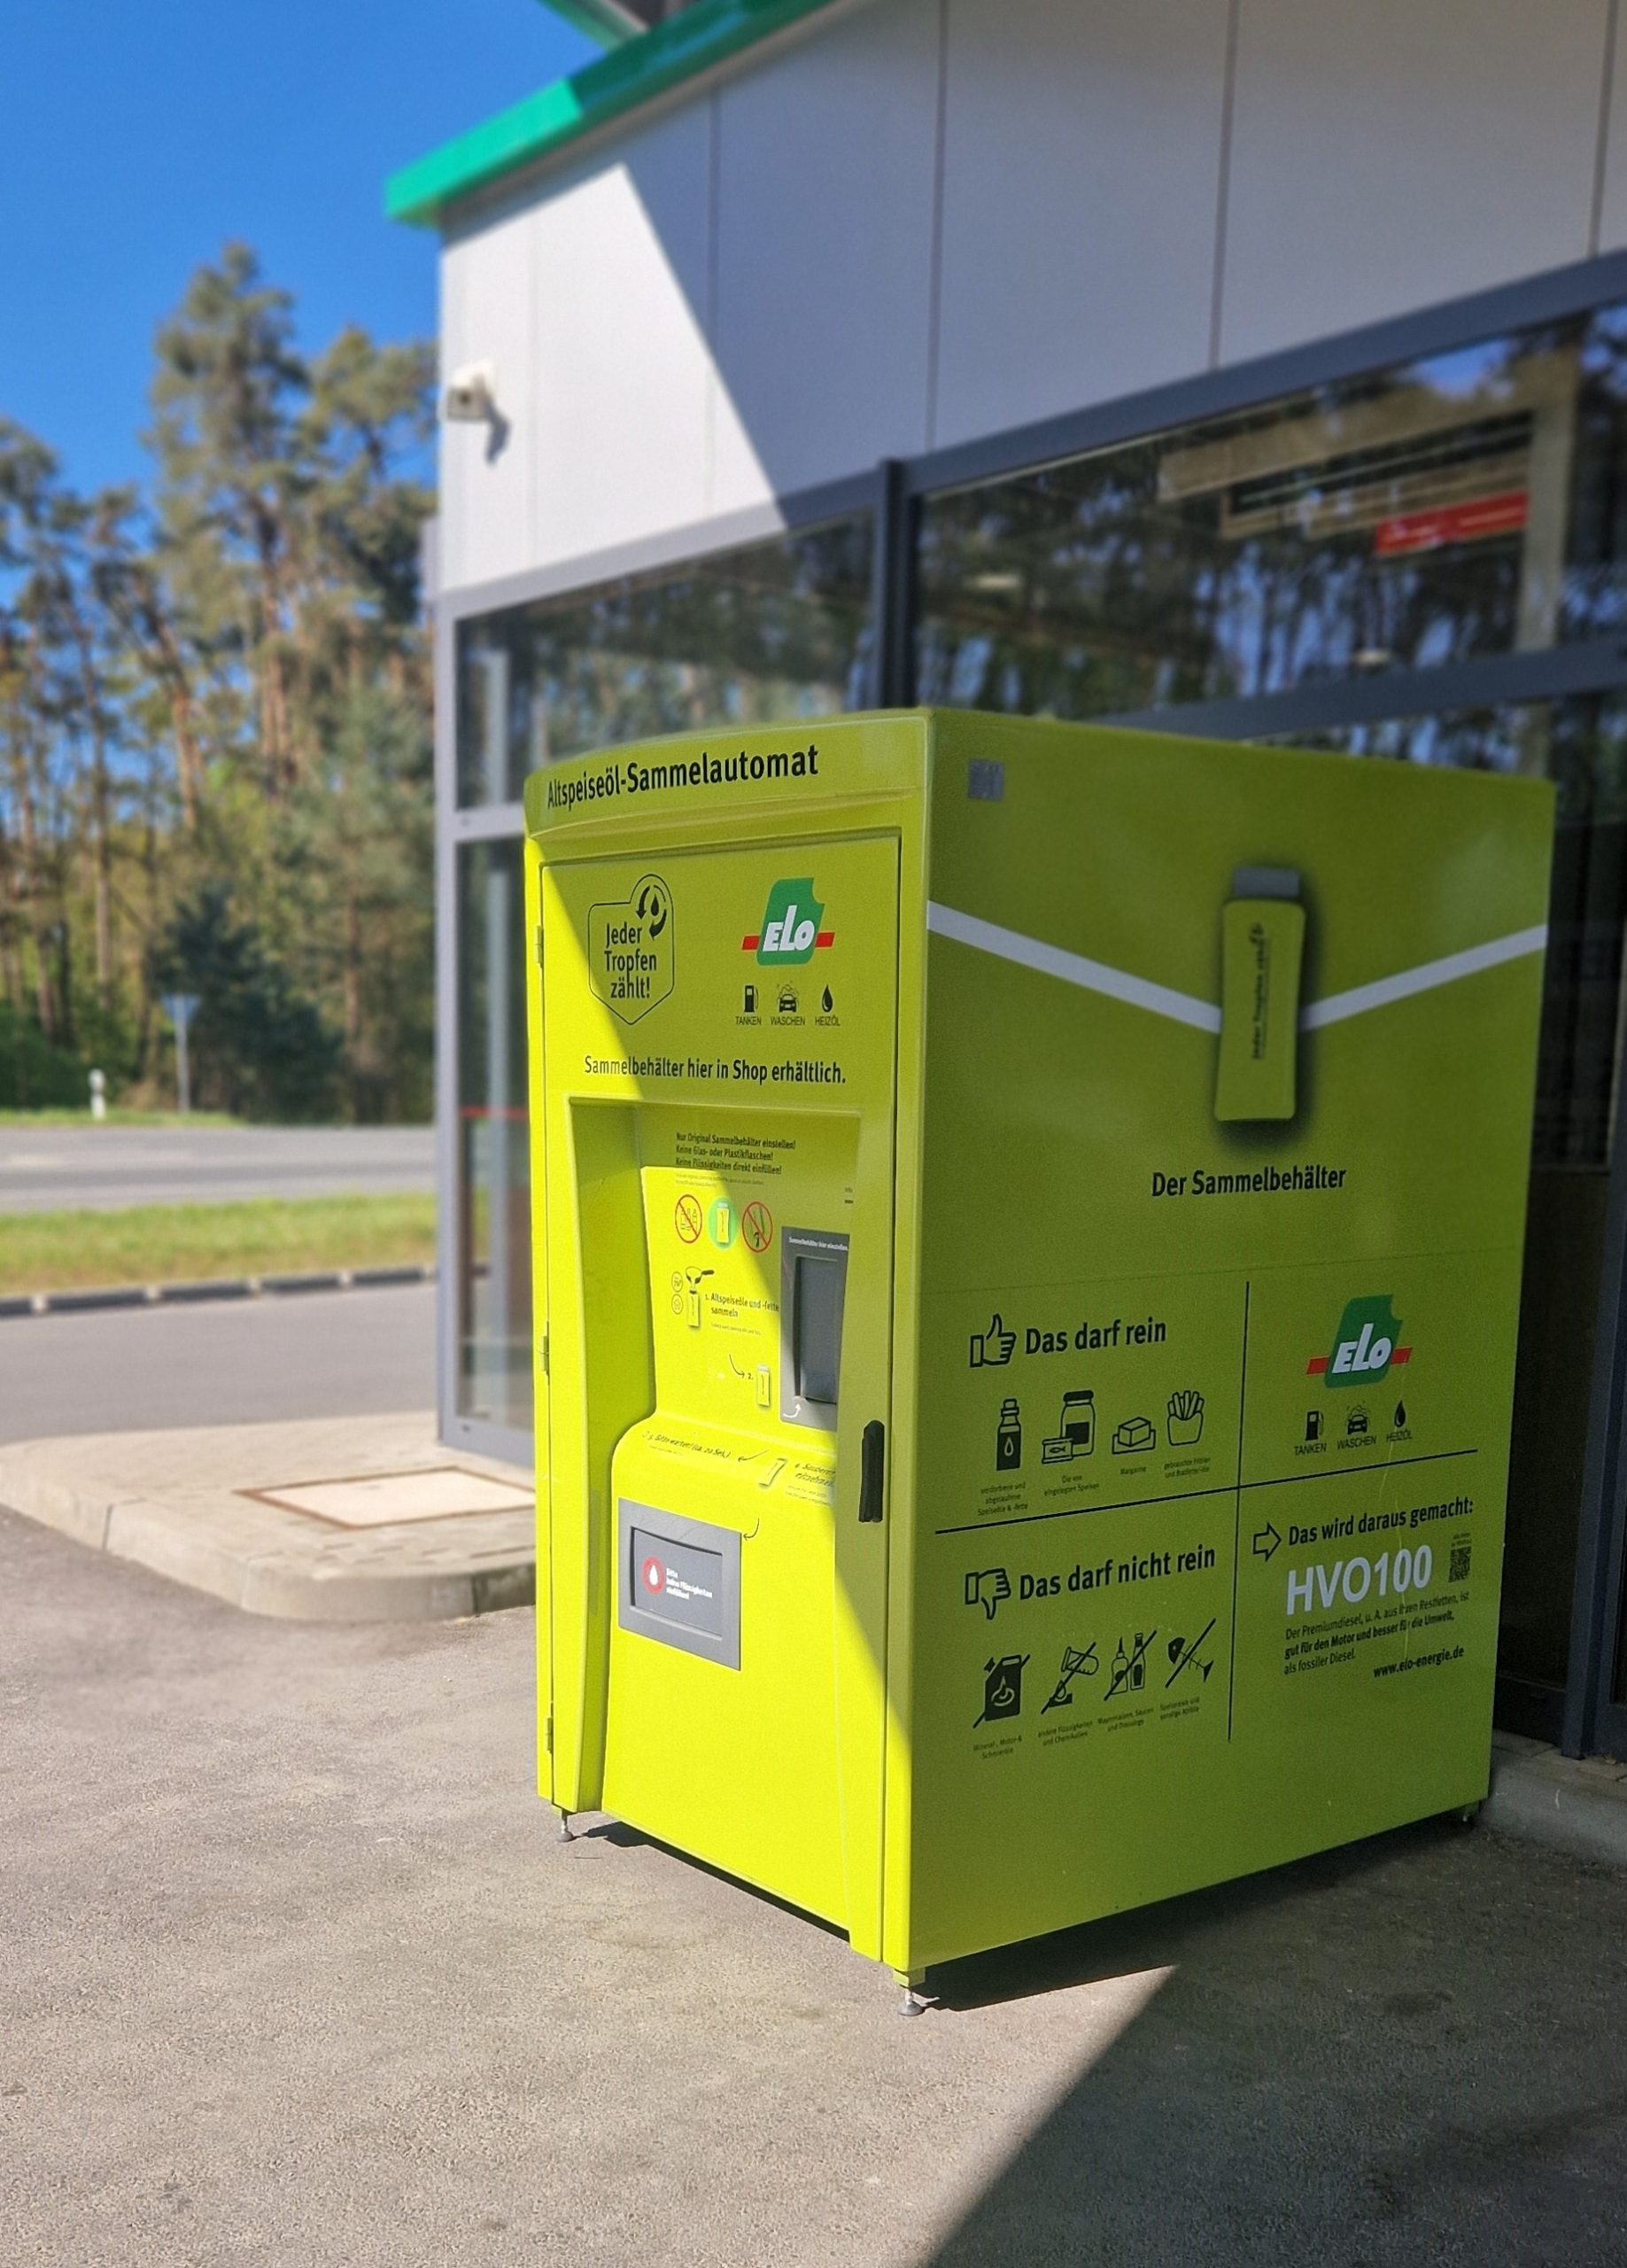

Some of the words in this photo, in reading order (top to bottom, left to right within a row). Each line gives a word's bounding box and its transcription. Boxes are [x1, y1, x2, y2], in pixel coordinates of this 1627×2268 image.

[546, 744, 819, 811] Altspeiseöl-Sammelautomat
[605, 921, 643, 946] Jeder
[604, 950, 657, 980] Tropfen
[610, 975, 651, 999] zählt!
[735, 1016, 762, 1027] TANKEN
[770, 1016, 805, 1027] WASCHEN
[814, 1014, 841, 1027] HEIZÖL
[585, 1056, 684, 1078] Sammelbehälter
[687, 1057, 712, 1079] hier
[717, 1059, 729, 1079] in
[732, 1059, 768, 1085] Shop
[771, 1061, 846, 1084] erhältlich.
[676, 1132, 687, 1142] Nur
[687, 1133, 710, 1145] Original
[711, 1134, 761, 1147] Sammelbehälter
[762, 1138, 796, 1150] einstellen!
[676, 1145, 692, 1155] Keine
[709, 1147, 723, 1158] oder
[724, 1149, 773, 1161] Plastikflaschen!
[676, 1158, 692, 1167] Keine
[693, 1158, 732, 1171] Flüssigkeiten
[733, 1161, 751, 1172] direkt
[1151, 1172, 1187, 1197] Der
[1191, 1164, 1346, 1195] Sammelbehälter
[710, 1293, 748, 1308] Altspeiseöle
[710, 1307, 739, 1318] sammeln
[1026, 1328, 1067, 1355] Das
[1074, 1319, 1121, 1349] darf
[1126, 1317, 1166, 1345] rein
[1293, 1442, 1327, 1456] TANKEN
[1336, 1435, 1377, 1450] WASCHEN
[1385, 1429, 1413, 1443] HEIZÖL
[1289, 1525, 1317, 1546] Das
[1321, 1515, 1354, 1540] wird
[1358, 1510, 1406, 1534] daraus
[1410, 1496, 1474, 1528] gemacht:
[1019, 1573, 1061, 1600] Das
[1067, 1559, 1113, 1591] darf
[1118, 1551, 1171, 1583] nicht
[1177, 1544, 1215, 1573] rein
[1286, 1544, 1432, 1616] HVO100
[1286, 1627, 1300, 1641] Der
[1383, 1606, 1398, 1619] aus
[1460, 1591, 1469, 1603] ist
[1283, 1644, 1299, 1660] gut
[1300, 1641, 1313, 1655] für
[1313, 1638, 1329, 1651] den
[1330, 1633, 1355, 1648] Motor
[1356, 1627, 1372, 1642] und
[1373, 1623, 1399, 1638] besser
[1411, 1616, 1423, 1628] die
[1283, 1660, 1298, 1675] als
[1298, 1655, 1329, 1673] fossiler
[1373, 1644, 1464, 1678] www.elo-energie.de
